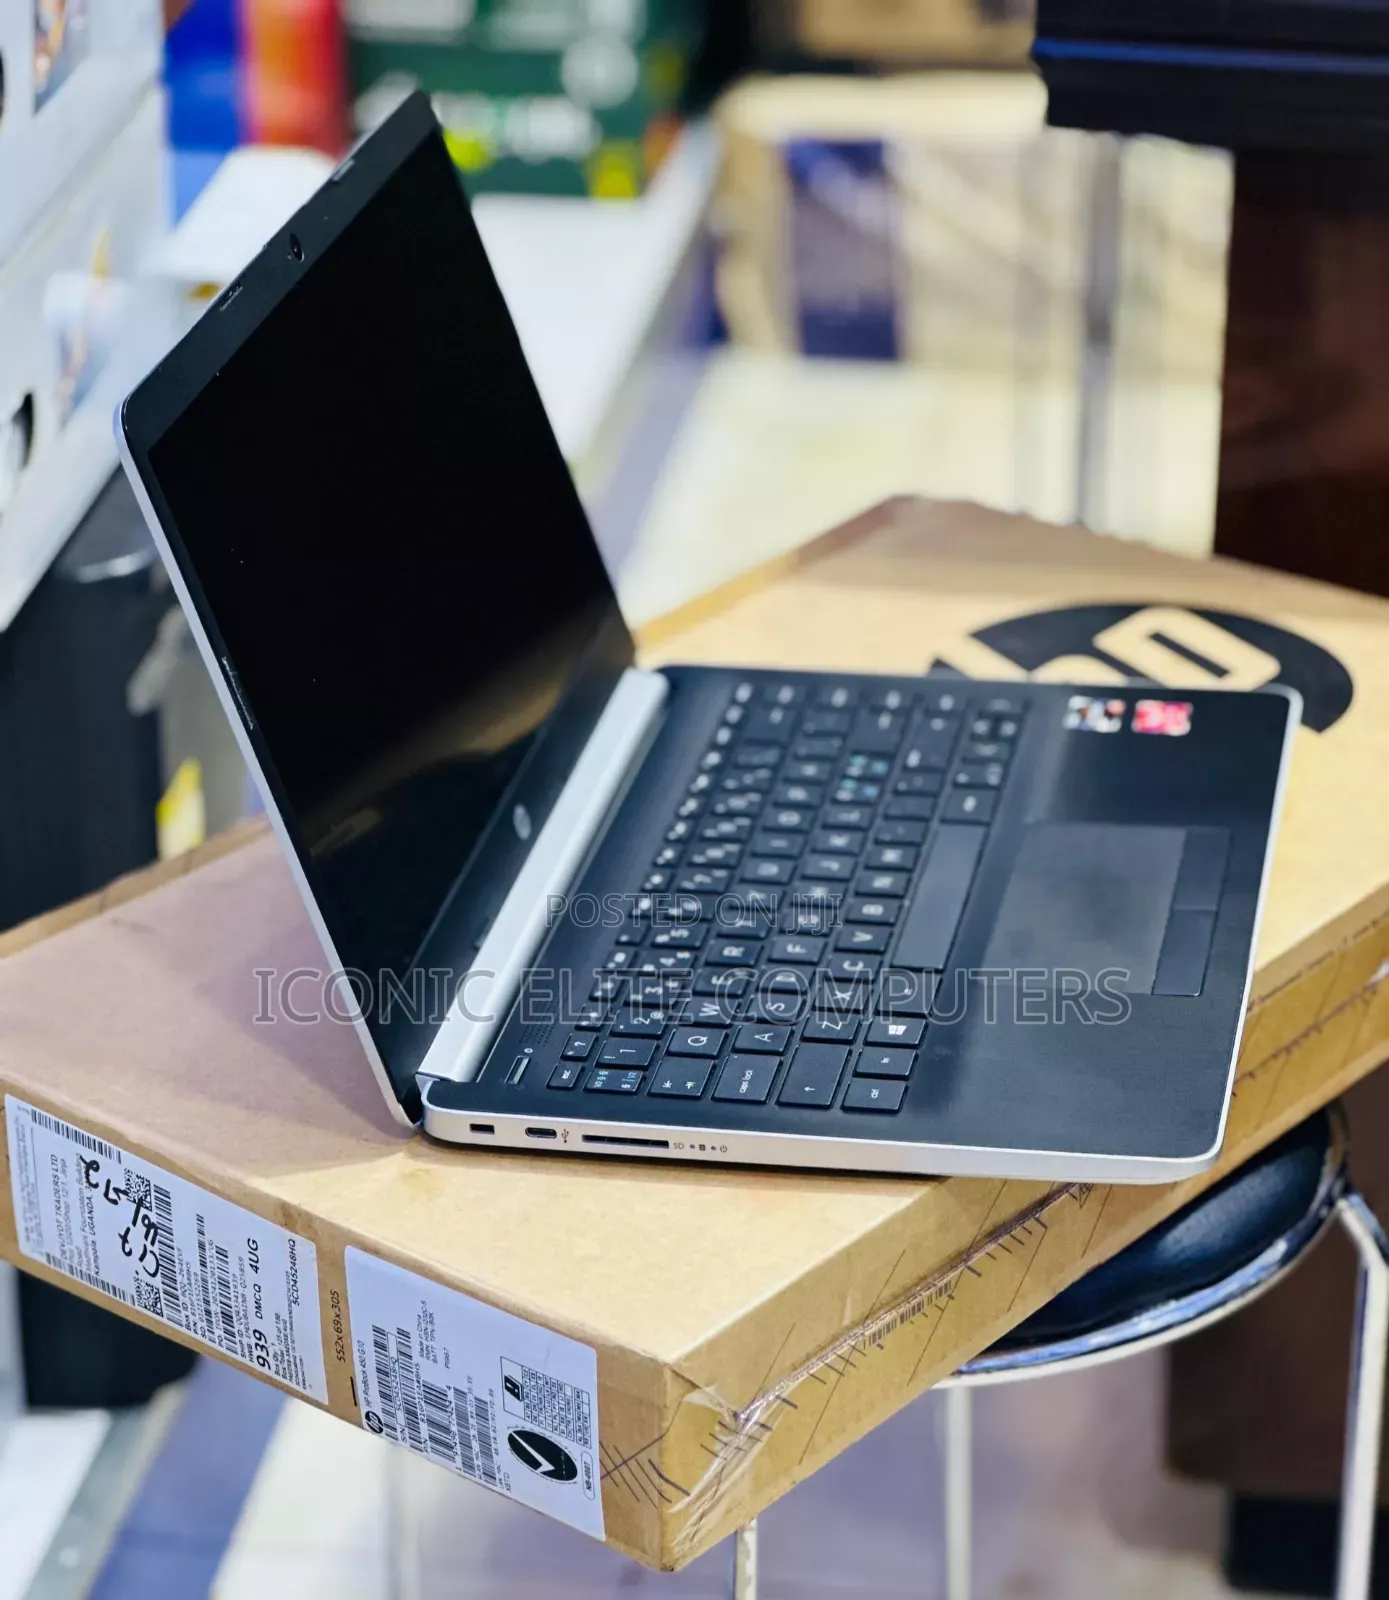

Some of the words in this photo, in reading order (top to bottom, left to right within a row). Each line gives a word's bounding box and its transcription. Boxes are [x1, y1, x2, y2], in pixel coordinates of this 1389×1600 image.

[862, 904, 884, 916] B
[852, 931, 874, 943] V
[722, 946, 745, 957] R
[786, 943, 807, 954] F
[842, 960, 864, 972] C
[833, 990, 853, 1001] X
[698, 1002, 720, 1017] W
[765, 1001, 786, 1013] S
[633, 1016, 651, 1026] 2
[821, 1020, 843, 1031] Z
[687, 1035, 709, 1047] Q
[753, 1032, 774, 1043] A
[673, 1141, 685, 1150] SD
[50, 1154, 59, 1173] LTD
[52, 1174, 61, 1216] TRADERS
[78, 1187, 87, 1233] Foundation
[247, 1238, 259, 1274] 4UG
[288, 1238, 300, 1306] 5CD45248HQ
[253, 1283, 263, 1320] DMCQ
[331, 1289, 348, 1363] 552x69x305
[252, 1329, 271, 1370] 939
[365, 1410, 384, 1434] hp
